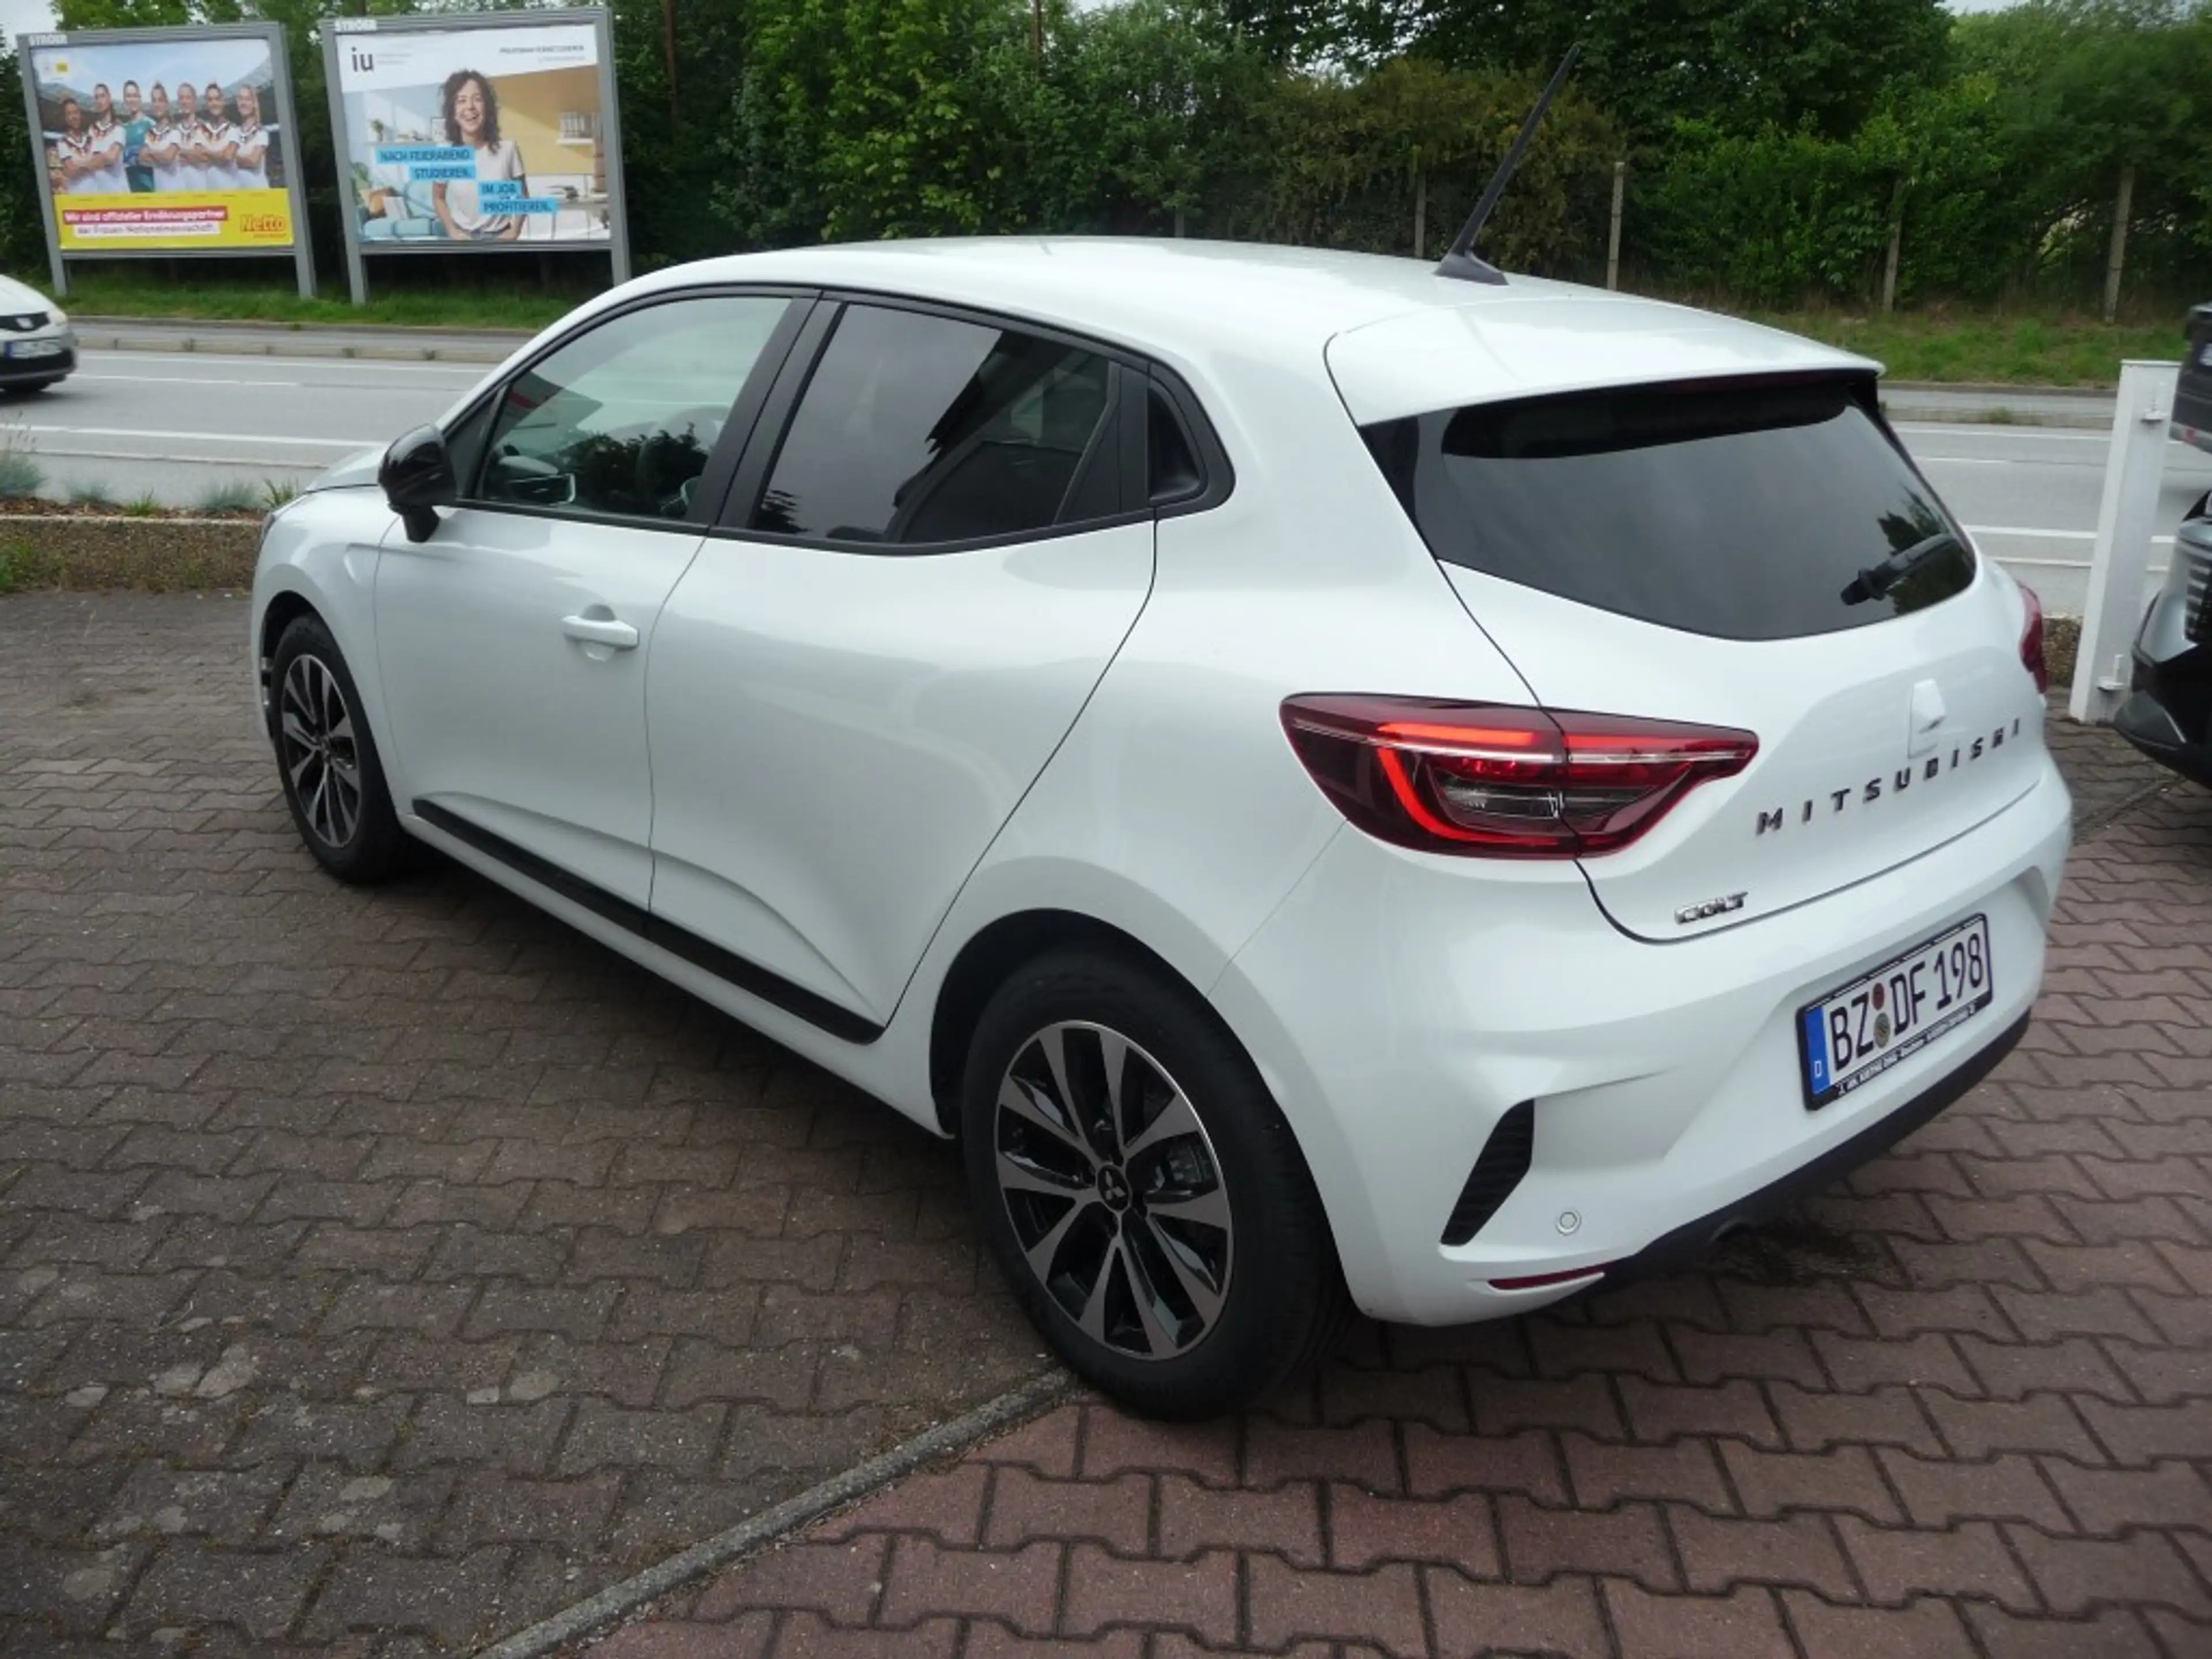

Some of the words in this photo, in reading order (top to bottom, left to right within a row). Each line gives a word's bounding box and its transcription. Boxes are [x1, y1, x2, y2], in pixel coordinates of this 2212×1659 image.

[351, 47, 374, 72] iu
[241, 215, 285, 232] Netto
[1756, 718, 2020, 835] MITSUBISHI
[1674, 891, 1748, 925] COLT
[1830, 991, 1874, 1072] BZ
[1890, 960, 1926, 1036] DF
[1933, 933, 1983, 1011] 198
